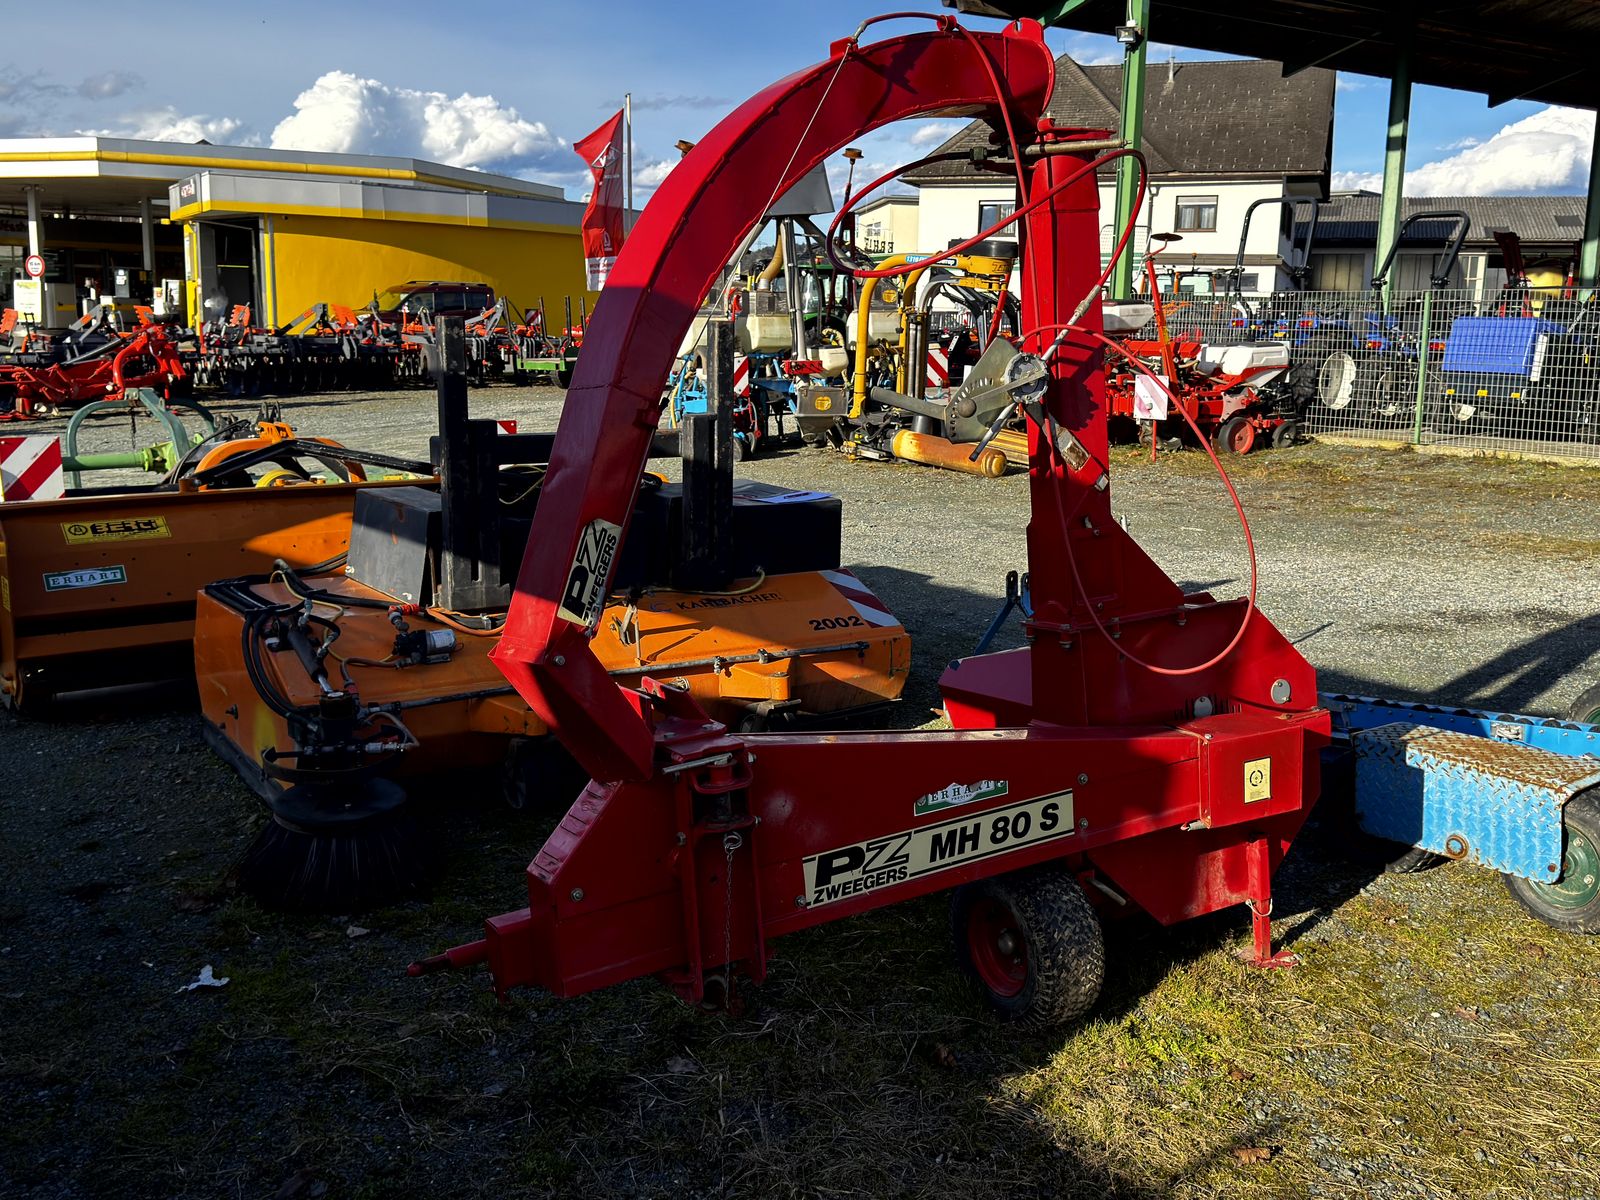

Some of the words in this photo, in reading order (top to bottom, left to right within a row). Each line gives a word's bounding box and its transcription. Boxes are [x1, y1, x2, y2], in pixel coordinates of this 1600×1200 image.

[51, 571, 119, 586] ERHART
[561, 521, 608, 620] PZ
[675, 592, 782, 611] KAHLBACHER
[808, 615, 865, 631] 2002
[929, 822, 981, 863] MH
[989, 811, 1031, 845] 80
[1039, 803, 1059, 831] S
[814, 831, 912, 888] PZ
[813, 866, 908, 904] ZWEEGERS
